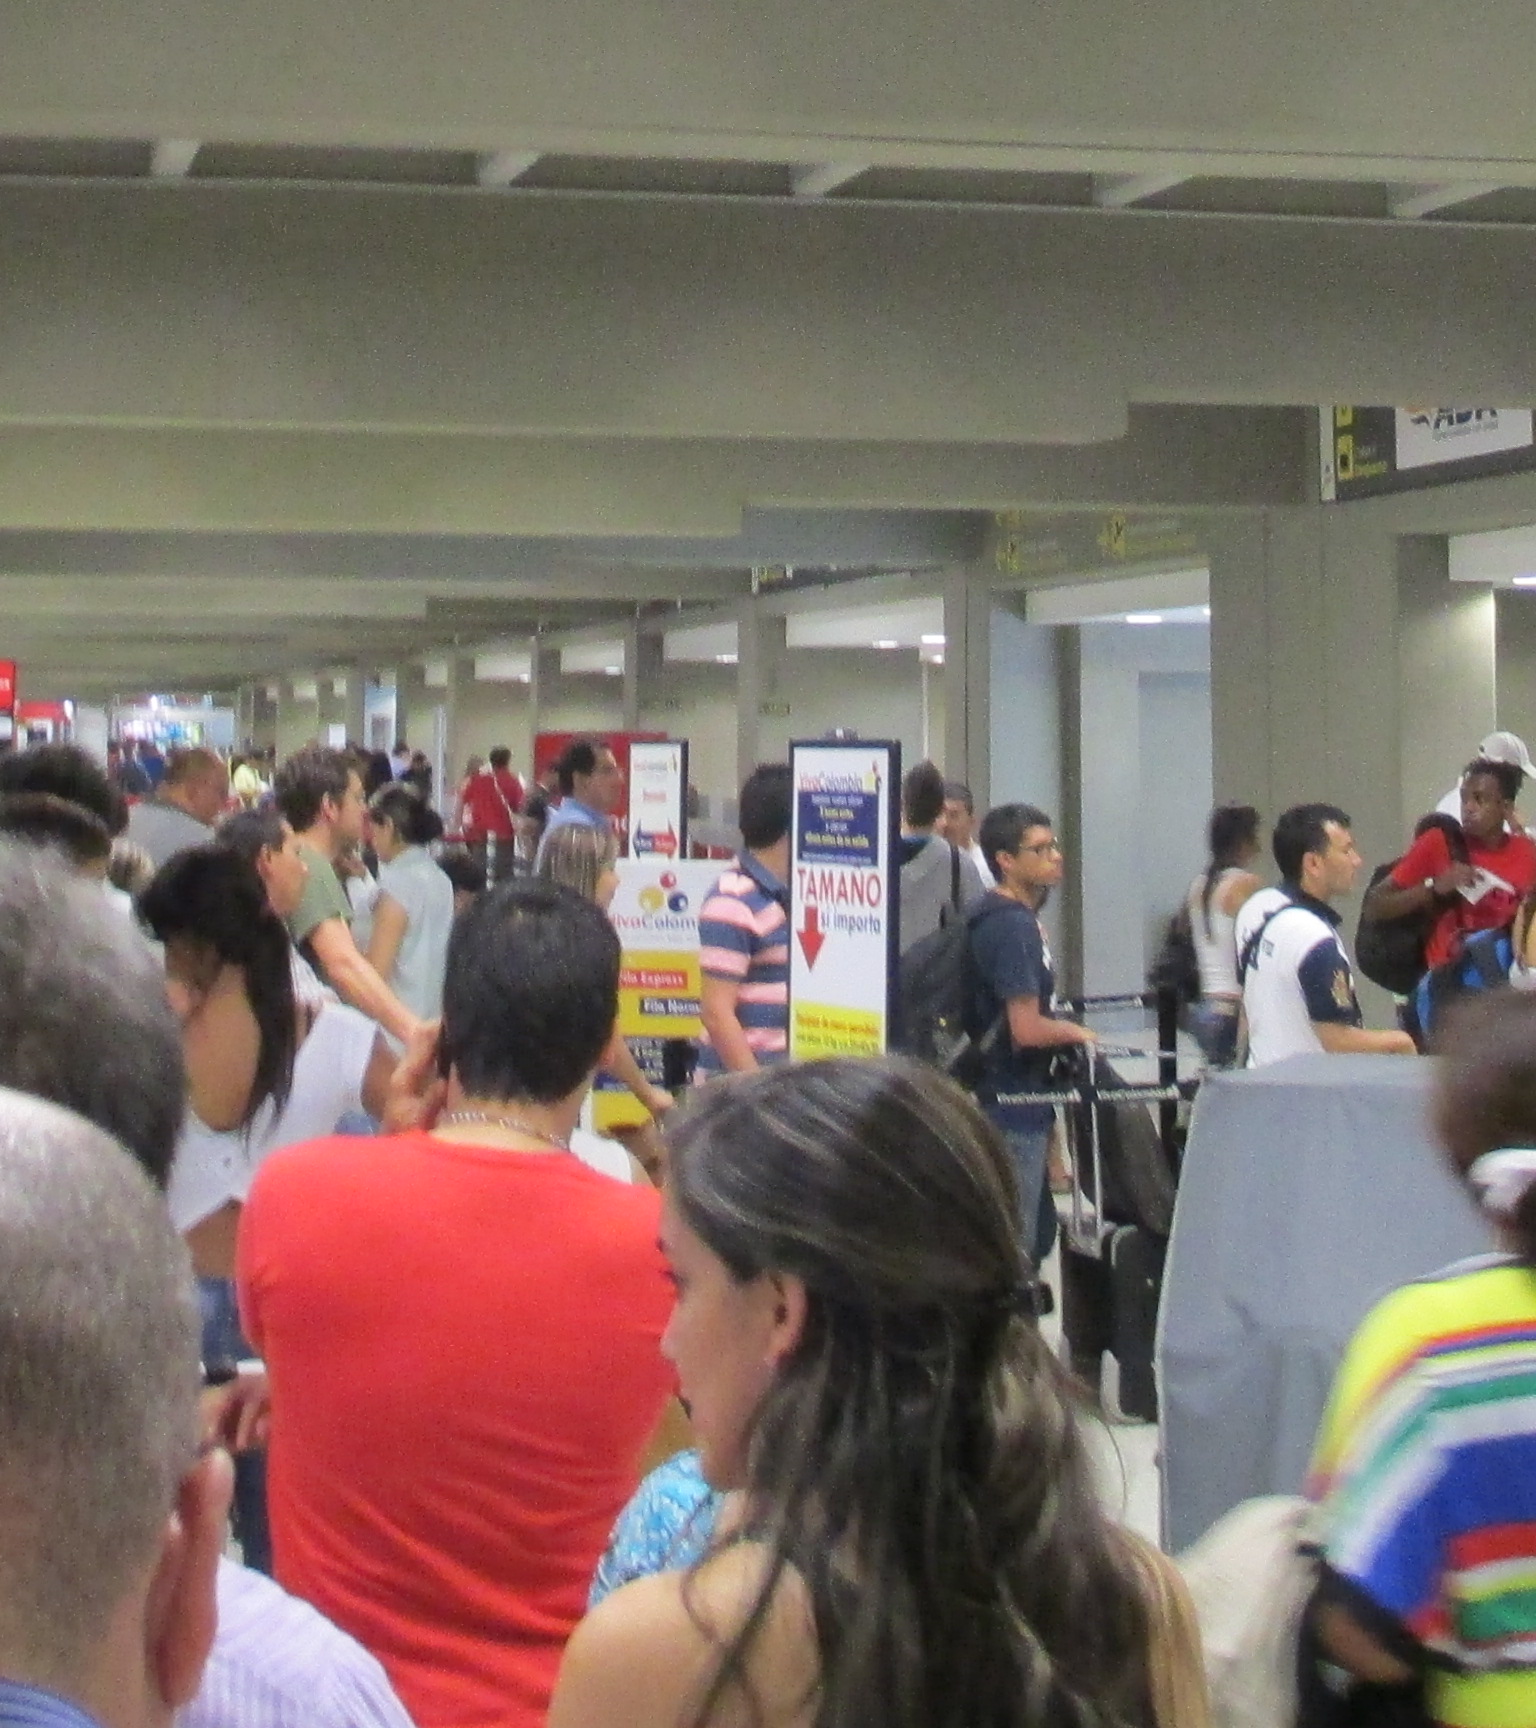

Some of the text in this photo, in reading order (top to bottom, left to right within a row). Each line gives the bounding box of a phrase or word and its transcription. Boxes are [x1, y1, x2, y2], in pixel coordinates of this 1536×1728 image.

[833, 906, 881, 938] importa
[640, 971, 684, 988] Express
[644, 997, 665, 1013] Fila
